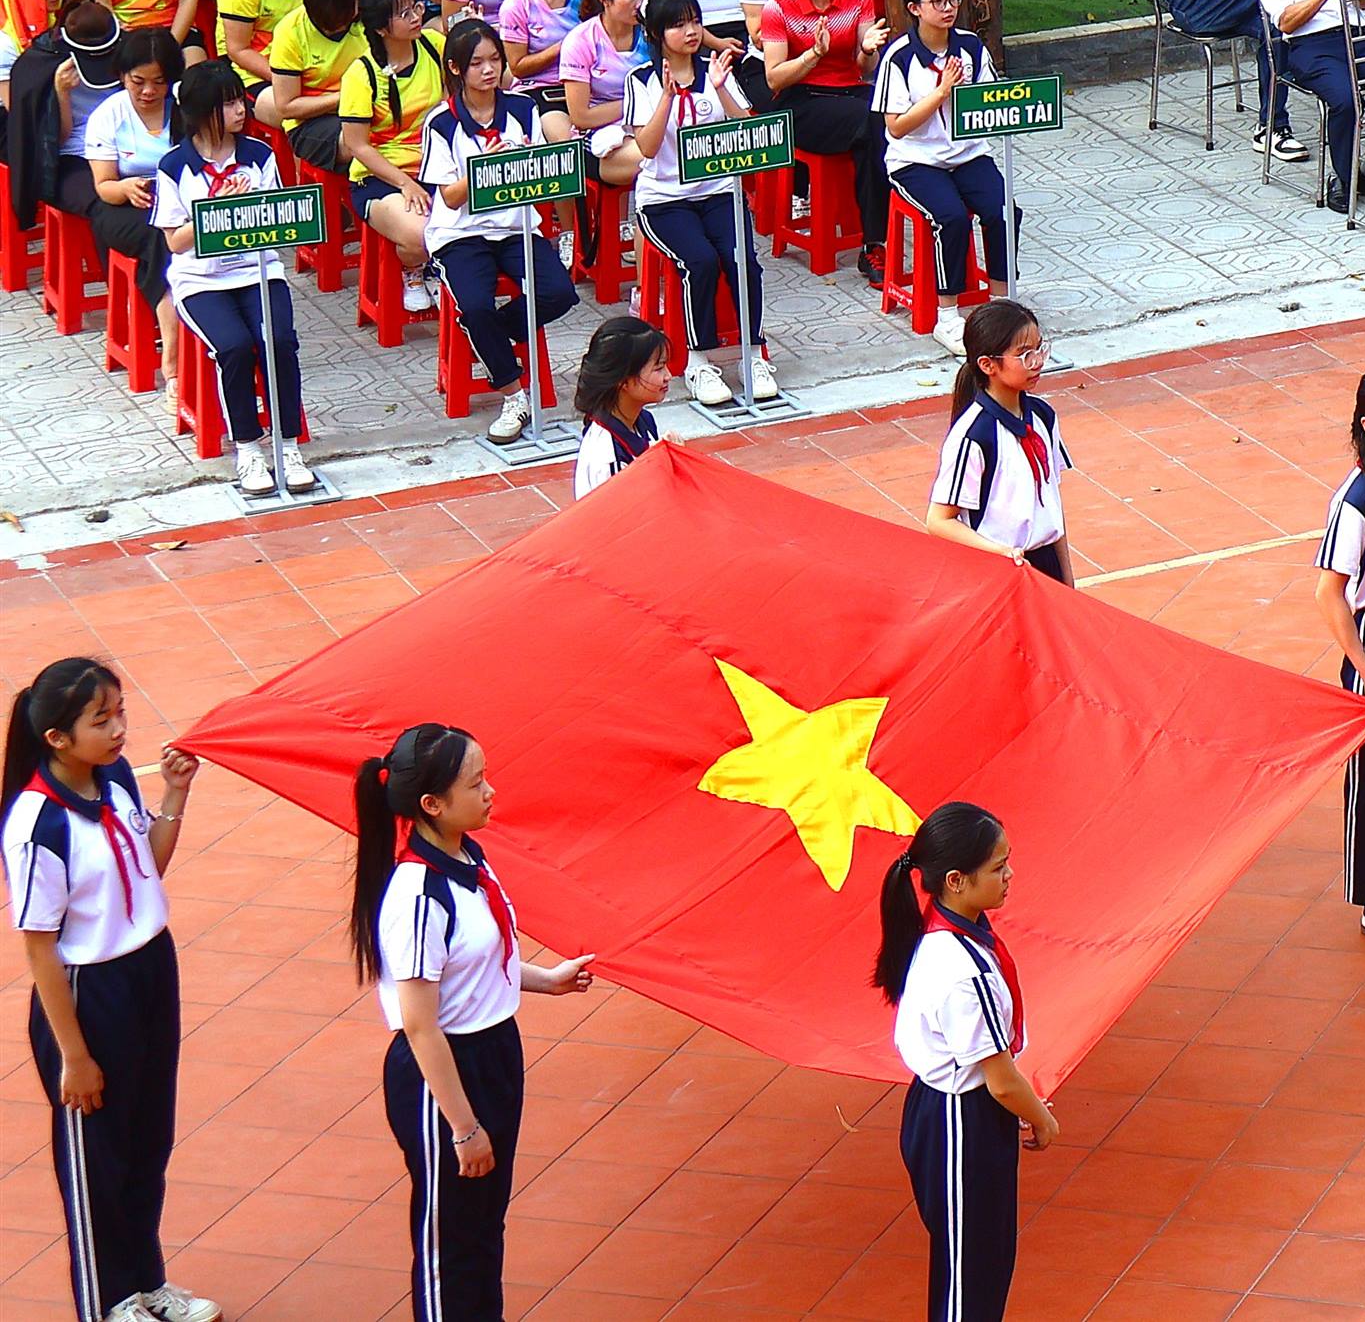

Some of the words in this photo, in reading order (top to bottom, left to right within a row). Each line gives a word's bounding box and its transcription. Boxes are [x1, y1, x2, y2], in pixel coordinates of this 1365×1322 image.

[983, 83, 1031, 103] KHỐI
[962, 106, 1020, 131] TRỌNG
[1025, 100, 1052, 123] TÀI
[686, 133, 712, 160] BÓNG
[752, 124, 768, 149] HƠI
[770, 119, 784, 146] NỮ
[476, 161, 502, 189] BÓNG
[543, 153, 559, 177] HƠI
[560, 148, 575, 175] NỮ
[705, 155, 754, 173] CỤM
[760, 152, 769, 164] 1
[495, 184, 544, 202] CỤM
[549, 182, 560, 193] 2
[202, 205, 232, 233] BÓNG
[277, 199, 295, 224] HƠI
[297, 195, 313, 222] NỮ
[224, 230, 279, 248] CỤM
[284, 229, 297, 241] 3
